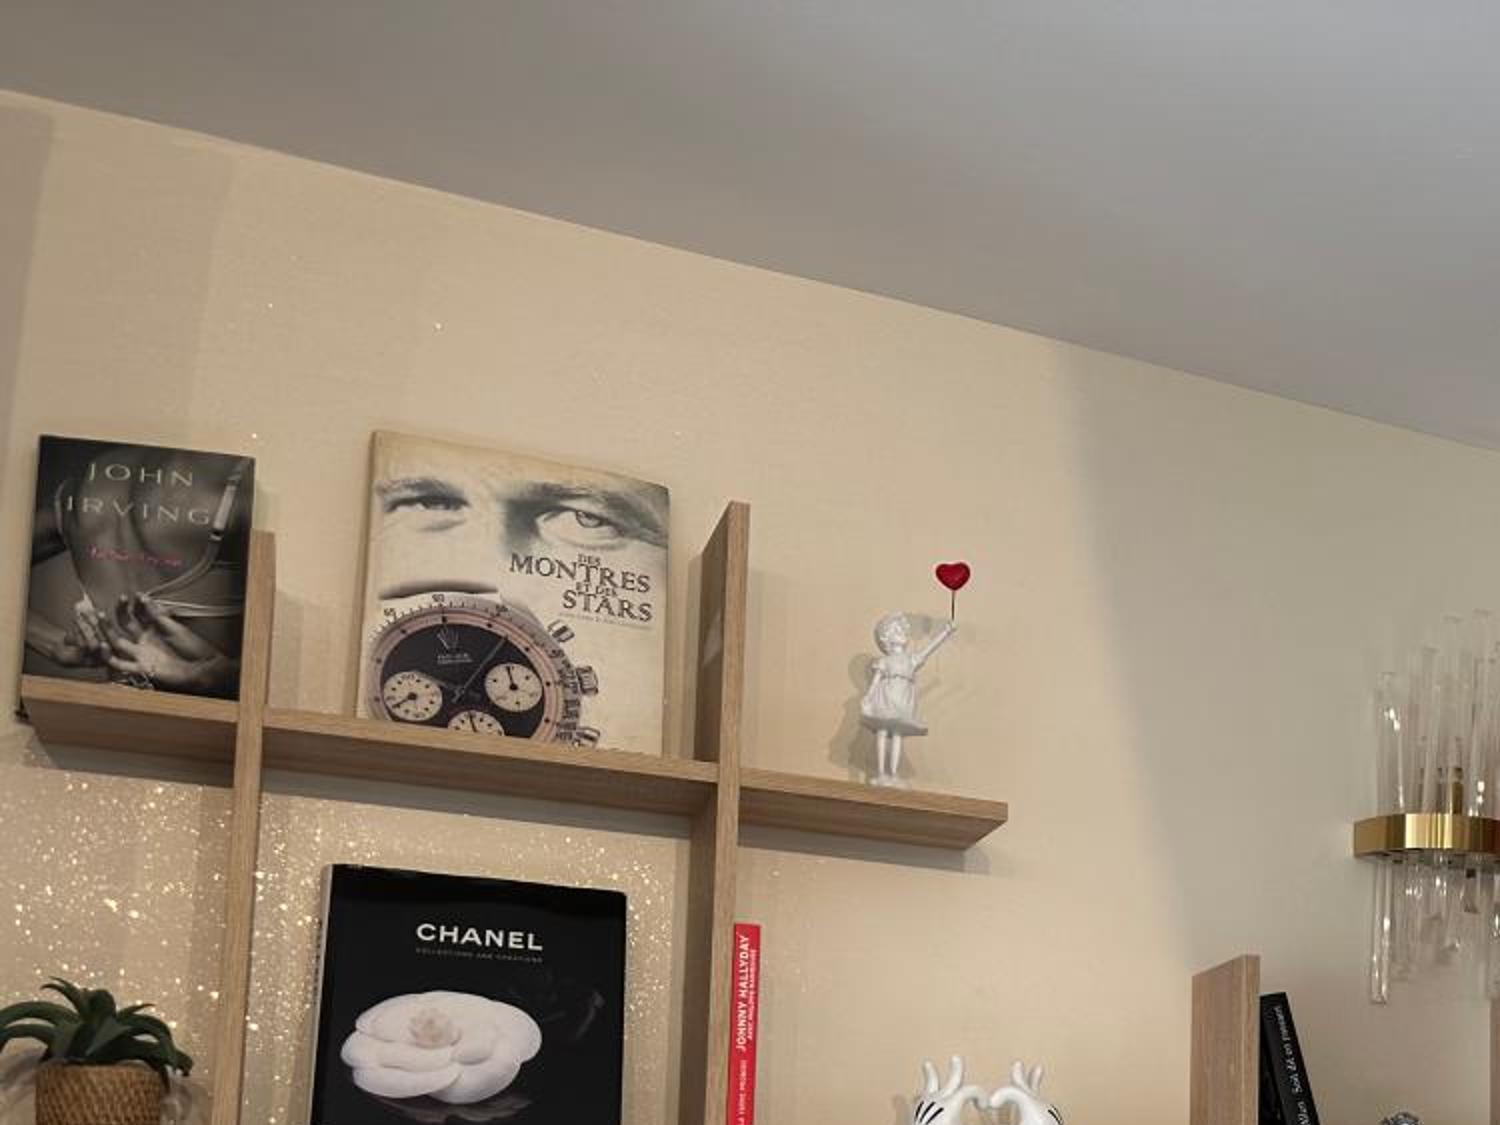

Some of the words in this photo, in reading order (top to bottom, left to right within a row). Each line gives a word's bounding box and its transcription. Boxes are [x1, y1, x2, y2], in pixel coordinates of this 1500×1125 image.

[88, 463, 193, 487] JOHN
[66, 495, 210, 526] IRVING
[509, 553, 651, 593] MONTRES
[562, 589, 653, 622] STARS
[416, 923, 543, 951] CHANEL
[738, 935, 749, 999] HALLYDAY
[735, 1000, 748, 1053] JOHNNY
